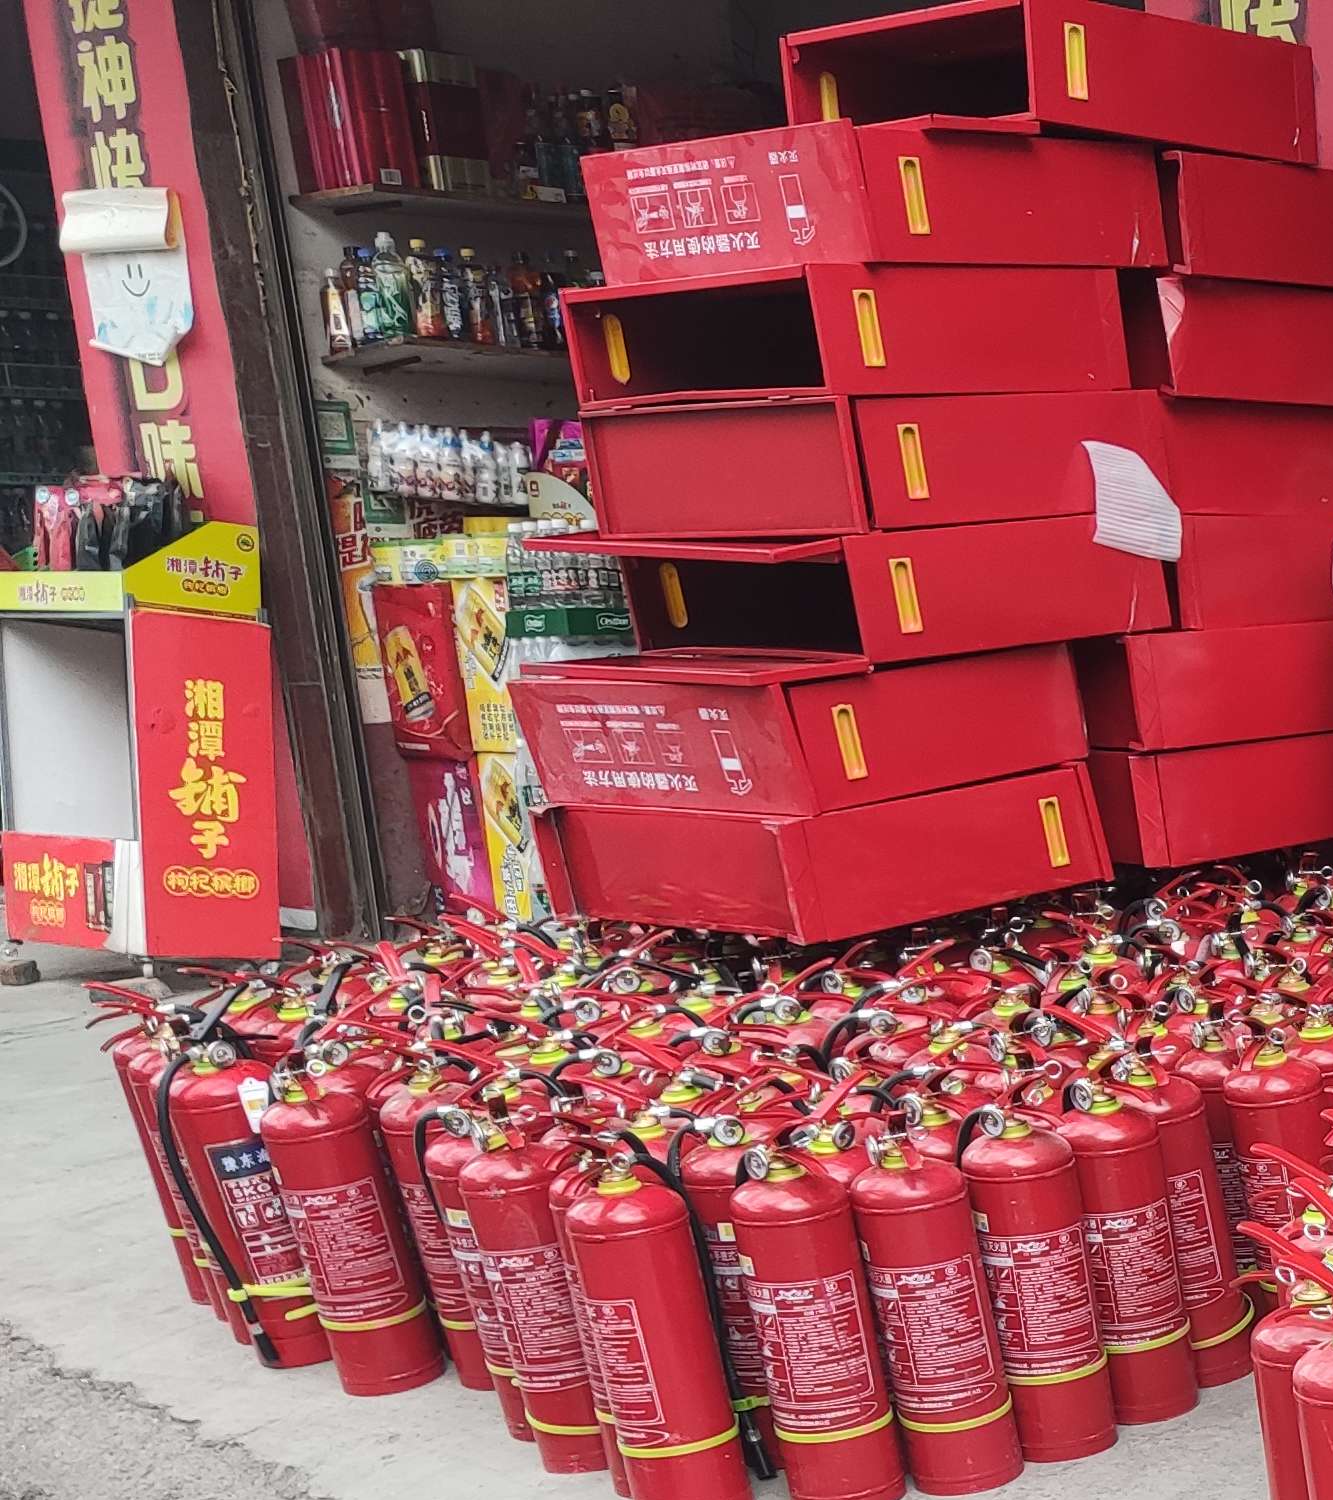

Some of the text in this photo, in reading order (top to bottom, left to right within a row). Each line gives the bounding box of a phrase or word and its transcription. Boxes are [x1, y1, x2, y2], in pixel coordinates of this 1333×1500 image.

[644, 231, 760, 260] 灭火器的使用方法
[167, 556, 244, 582] 湘潭铺子
[169, 679, 247, 859] 湘潭铺子
[583, 770, 699, 791] 灭火器的使用方法
